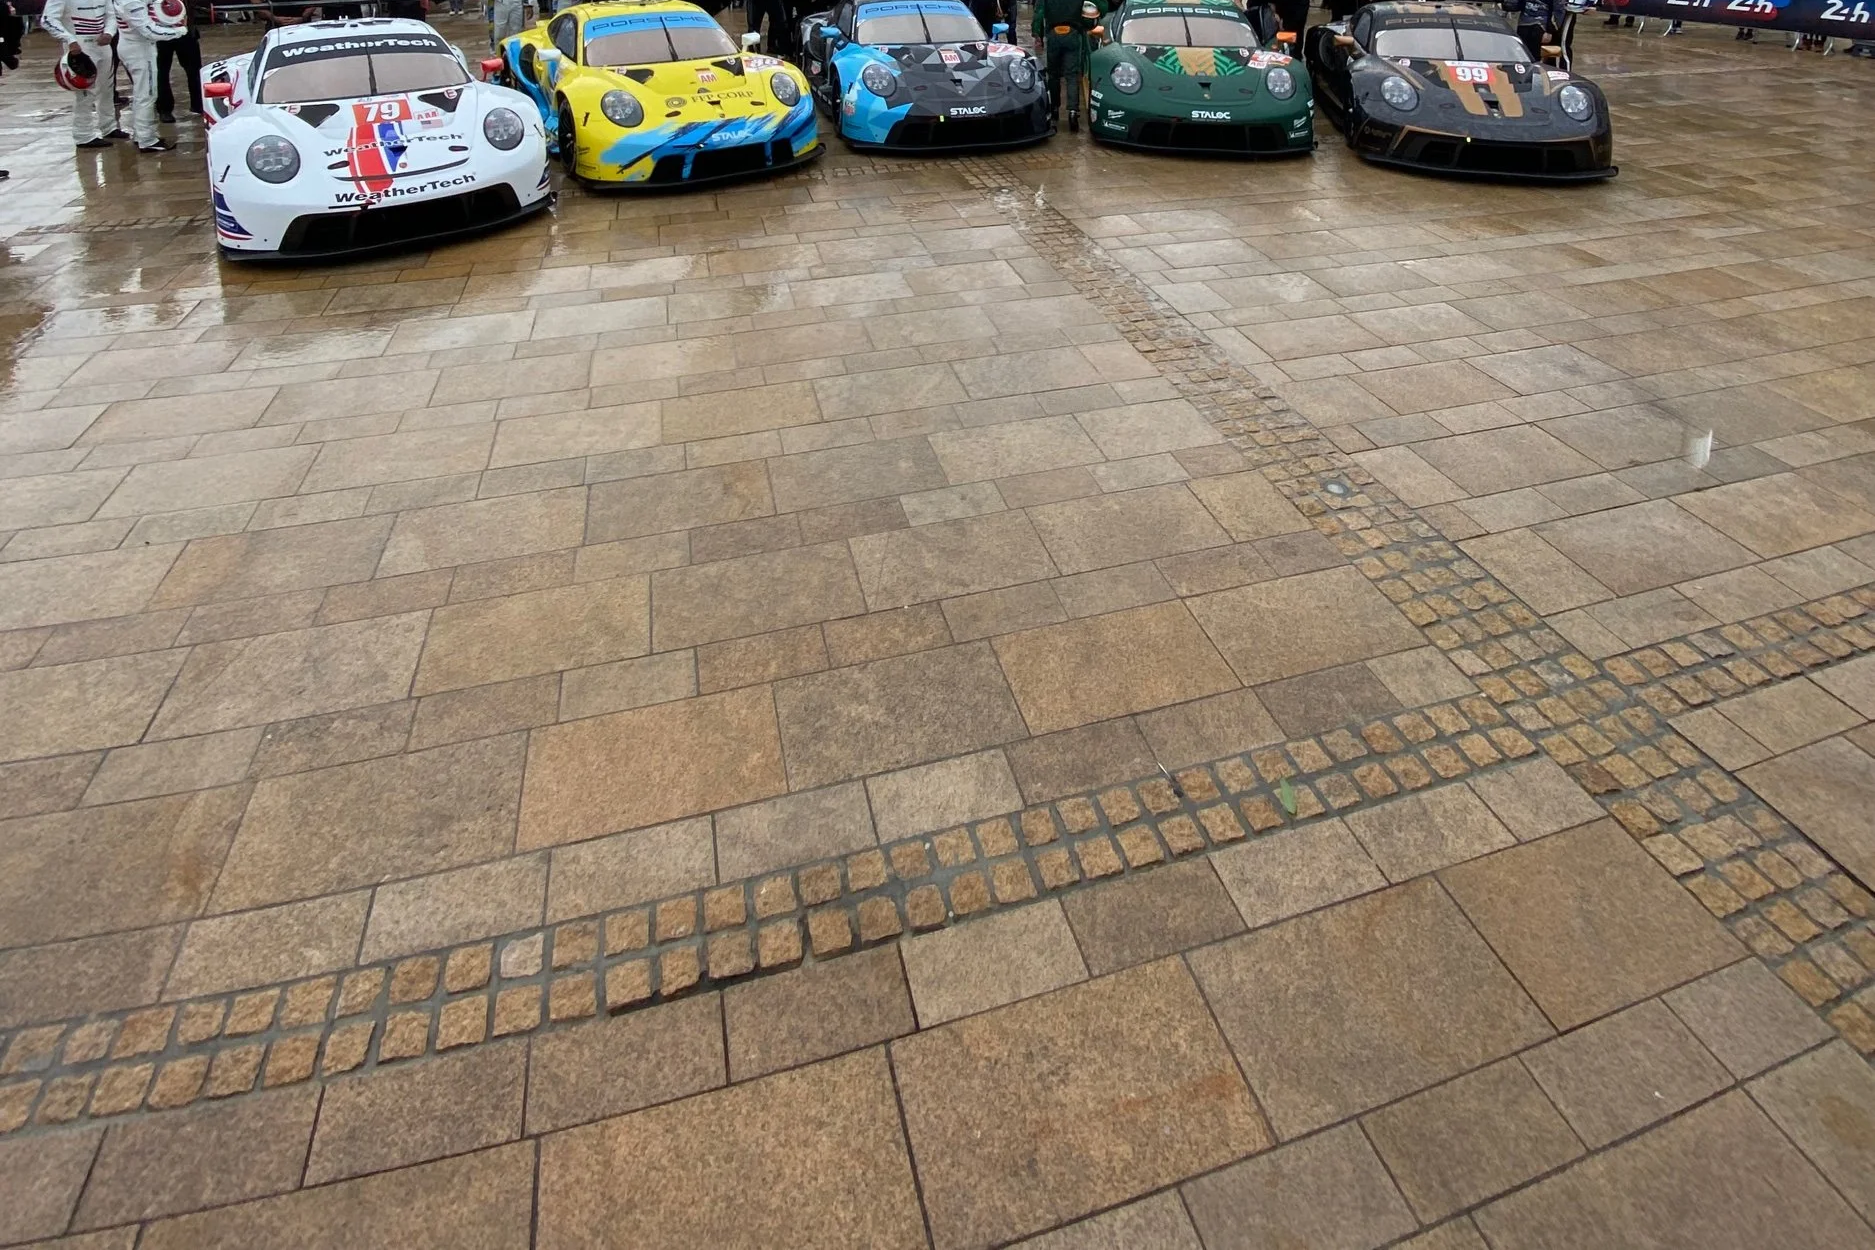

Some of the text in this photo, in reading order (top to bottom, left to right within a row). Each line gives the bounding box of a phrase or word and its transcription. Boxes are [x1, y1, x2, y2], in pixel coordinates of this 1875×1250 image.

[864, 3, 964, 14] PORSCHE
[1131, 6, 1239, 18] PORSCHE
[1820, 0, 1871, 23] 24h
[592, 15, 710, 31] PORSCHE
[1385, 17, 1504, 29] PORSCHE
[282, 38, 438, 58] WeatherTech
[700, 74, 717, 83] AM
[1455, 67, 1489, 82] 99
[717, 91, 753, 100] CORP
[363, 101, 401, 122] 79
[950, 106, 986, 115] STALOC
[1191, 110, 1231, 119] STALOC
[323, 134, 463, 156] WeatherTech
[335, 174, 476, 203] WeatherTech
